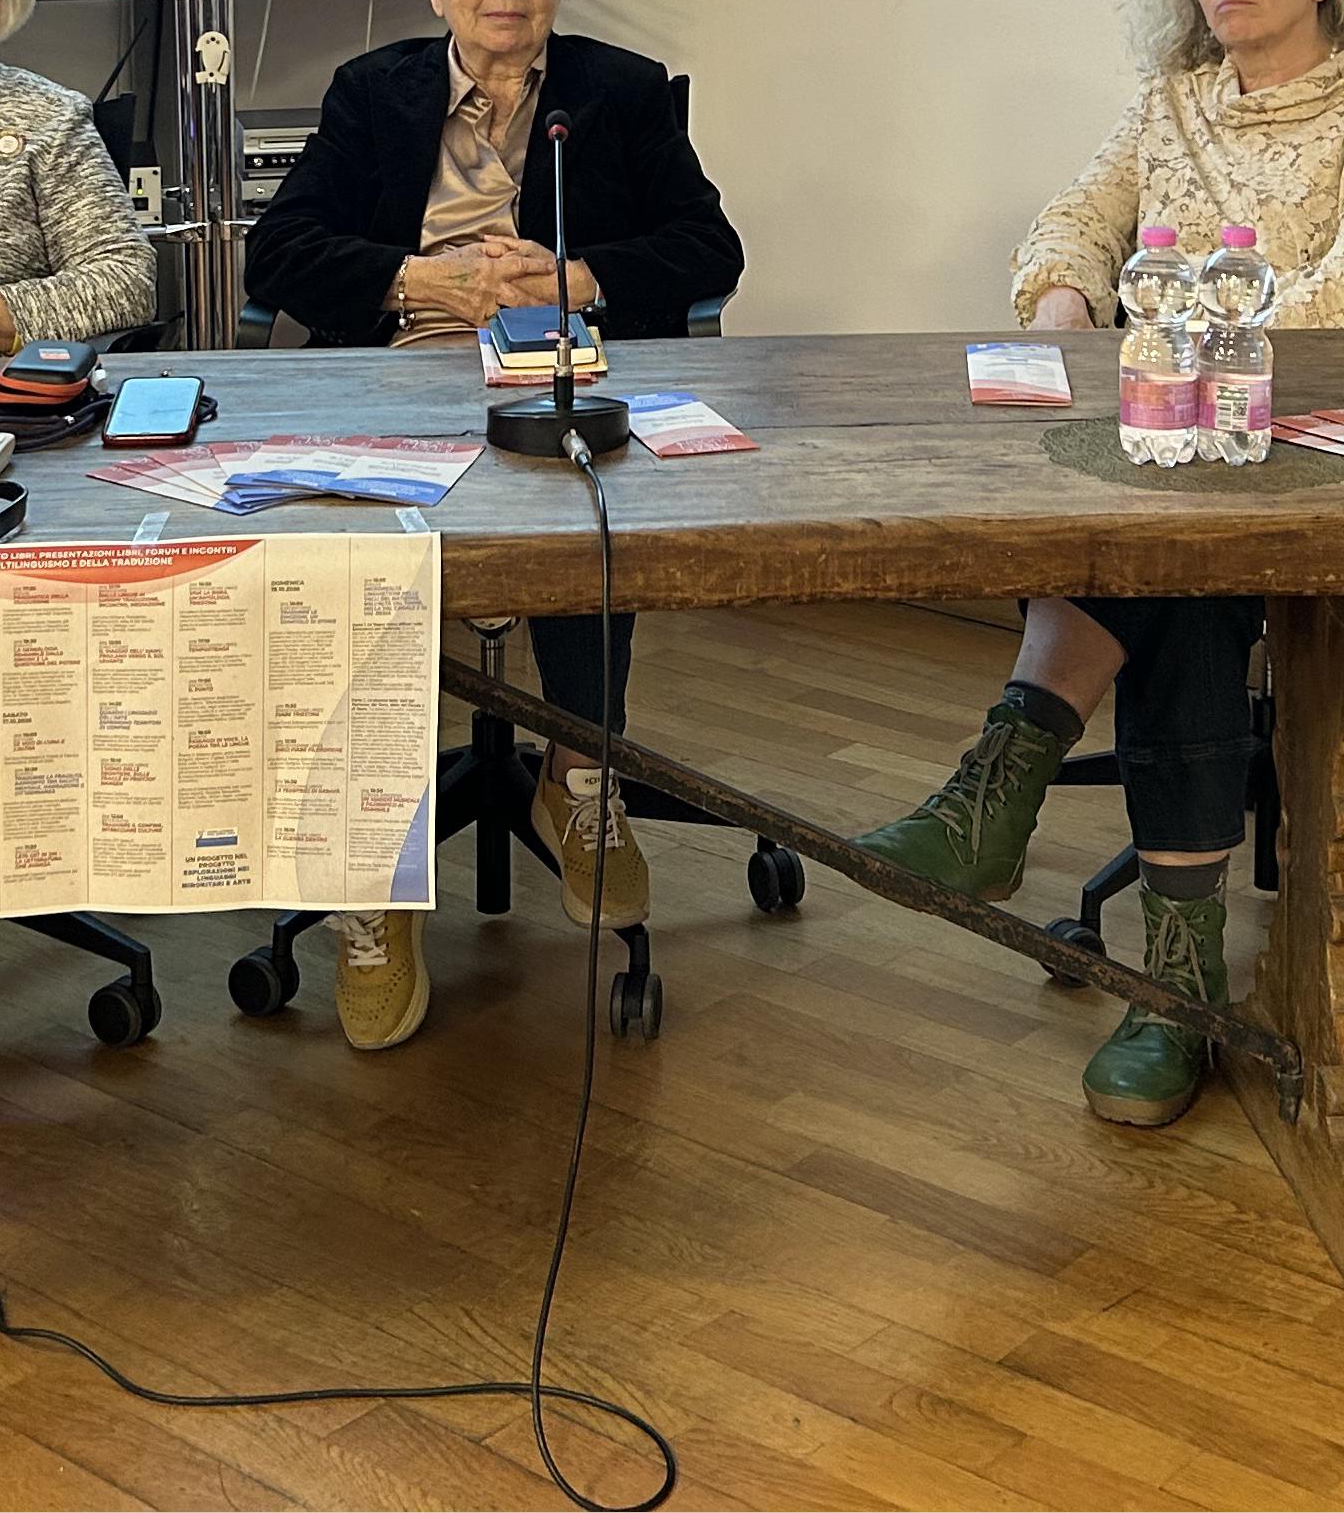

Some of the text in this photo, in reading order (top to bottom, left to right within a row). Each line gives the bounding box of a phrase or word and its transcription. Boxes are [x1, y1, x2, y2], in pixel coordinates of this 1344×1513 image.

[39, 550, 115, 560] PRESENTAZIONI
[145, 548, 180, 557] FORUM
[79, 558, 110, 568] DELLA
[111, 557, 173, 566] TRADUZIONE
